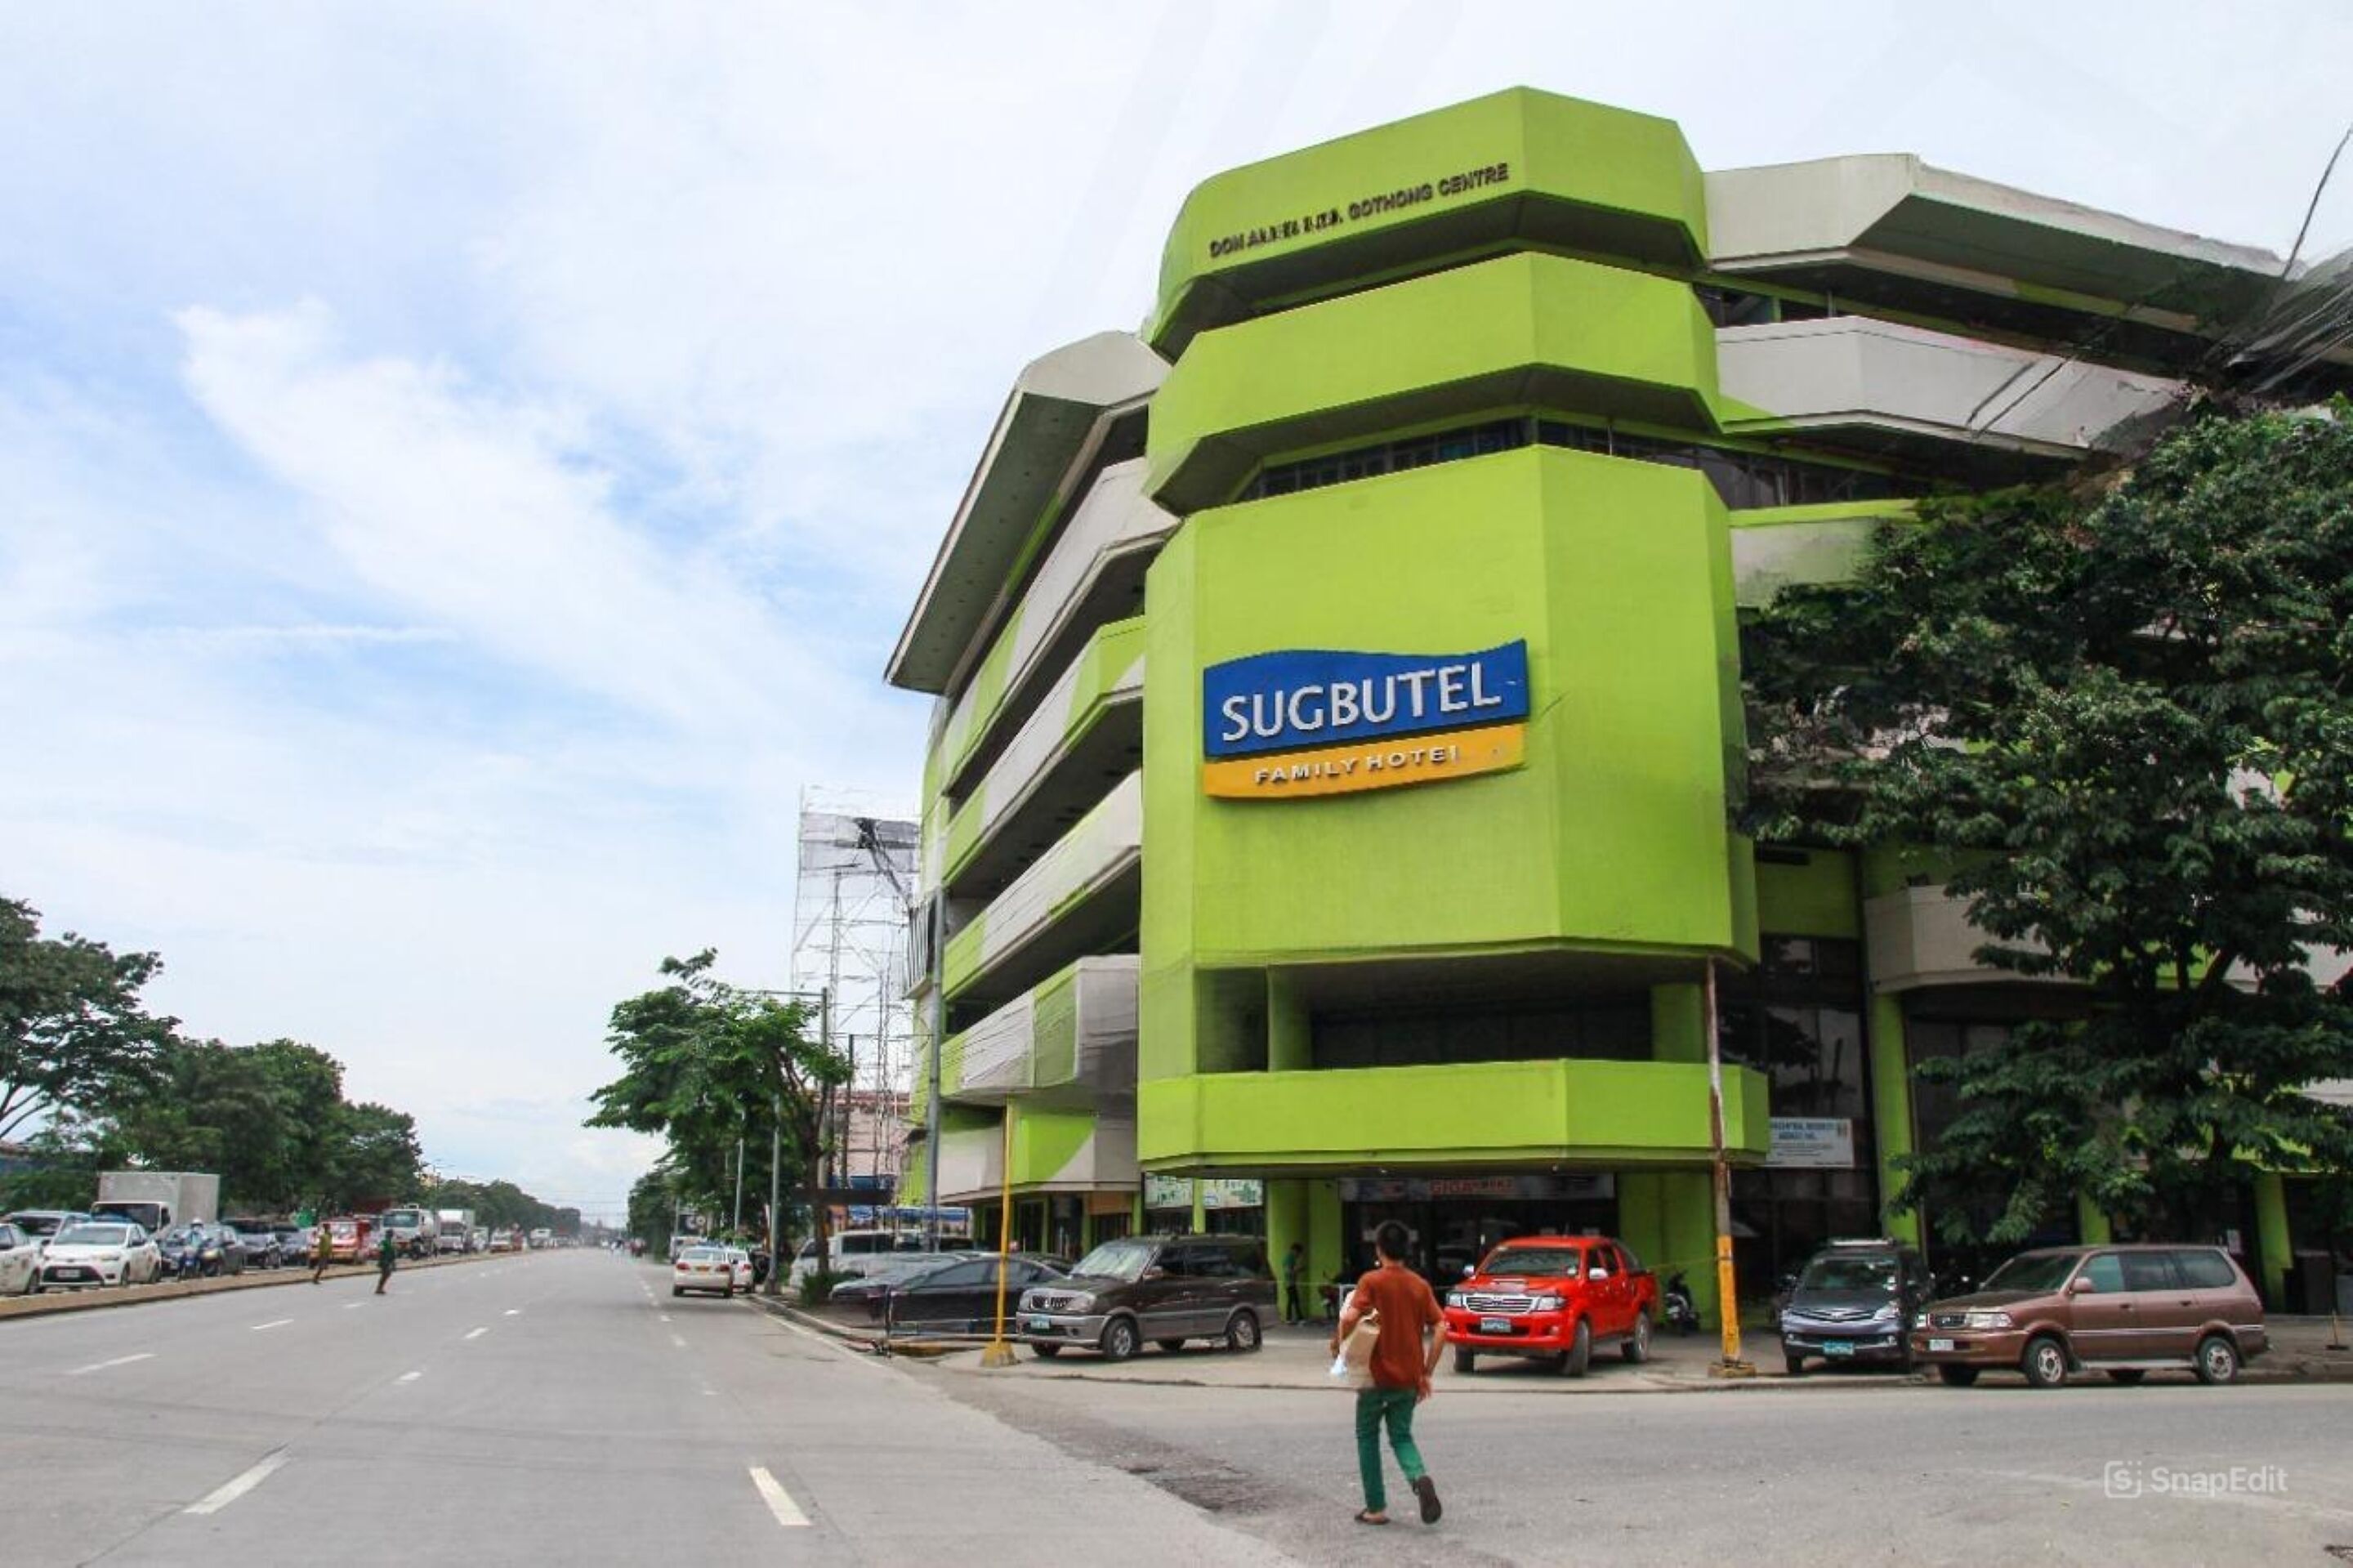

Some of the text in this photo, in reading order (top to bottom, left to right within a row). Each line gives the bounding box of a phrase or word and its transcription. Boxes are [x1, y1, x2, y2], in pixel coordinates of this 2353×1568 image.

[1348, 183, 1433, 220] GOTHONG
[1437, 163, 1509, 196] CENTRE
[1221, 660, 1502, 742] SUGBUTEL
[1255, 757, 1358, 784] FAMILY
